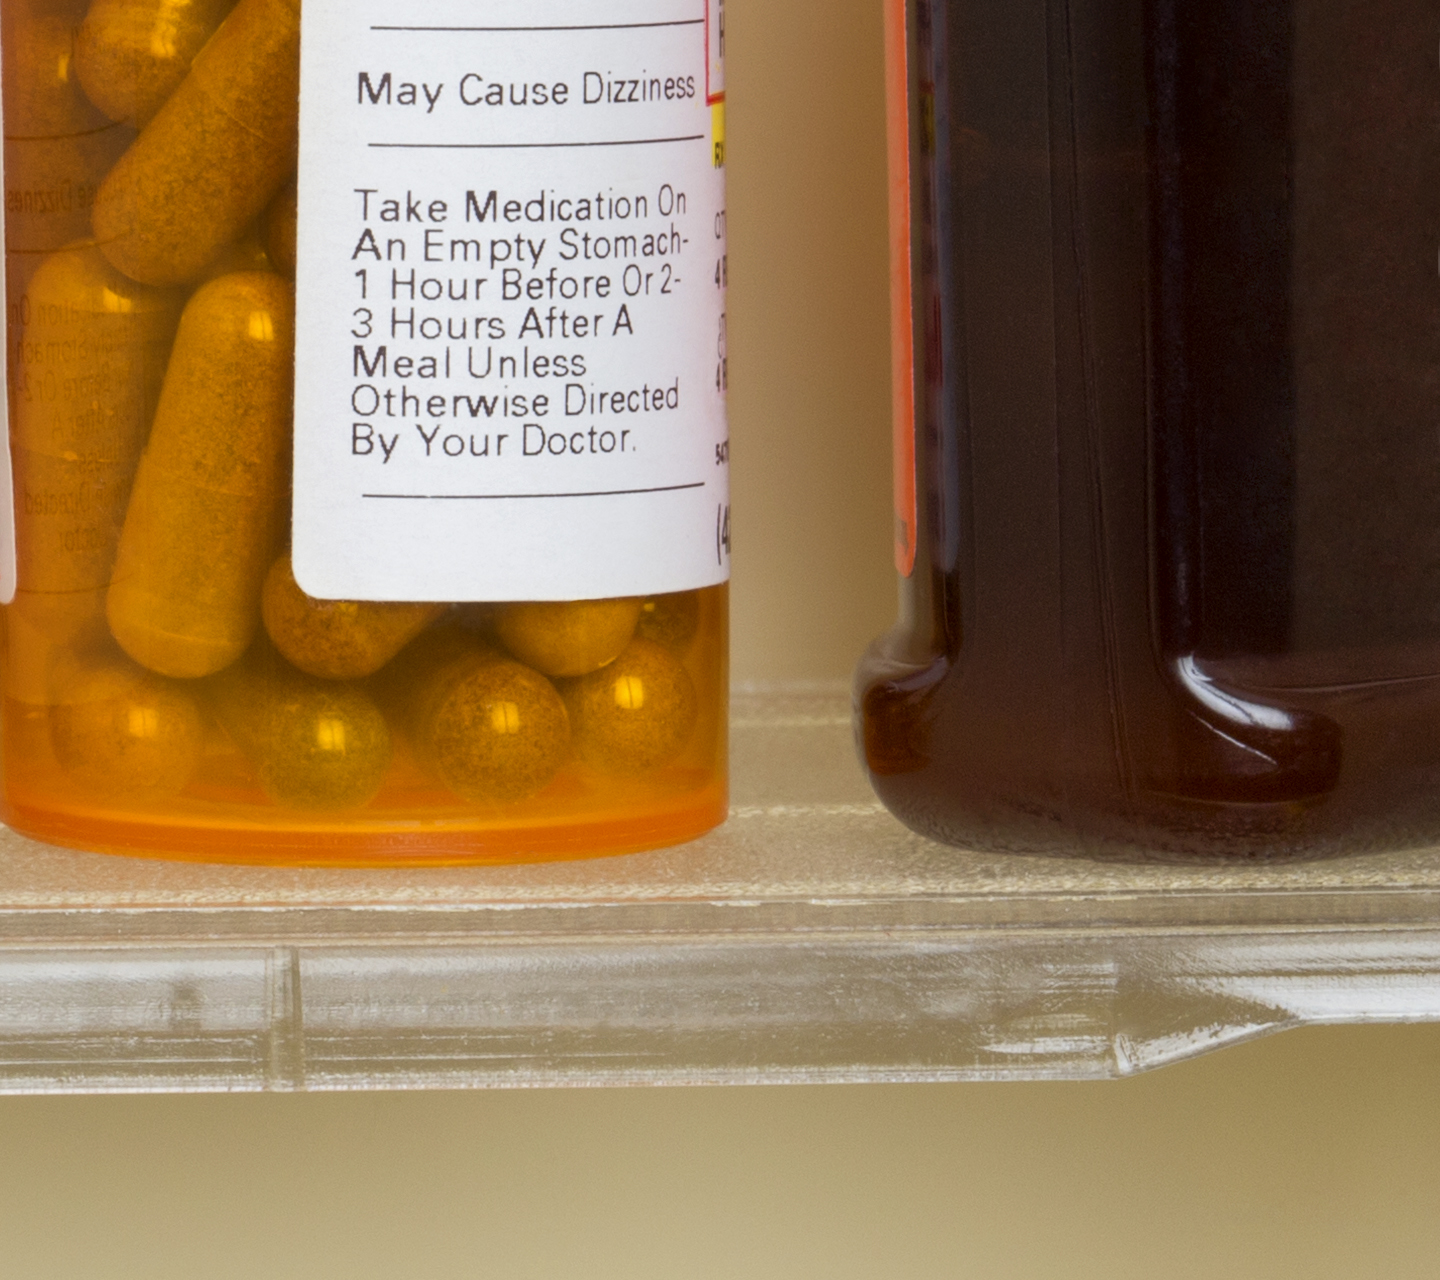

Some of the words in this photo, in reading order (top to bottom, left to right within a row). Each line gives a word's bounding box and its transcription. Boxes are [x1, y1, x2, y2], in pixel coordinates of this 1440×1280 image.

[357, 71, 444, 114] May
[459, 72, 569, 107] Cause
[582, 71, 696, 105] Dizziness
[353, 188, 448, 223] Take
[465, 189, 648, 223] Medication
[657, 183, 686, 217] On
[350, 227, 406, 262] An
[423, 228, 547, 271] Empty
[558, 222, 689, 261] Stomach-
[354, 268, 367, 300] 1
[391, 267, 488, 301] Hour
[501, 266, 611, 301] Before
[622, 263, 654, 297] Or
[350, 307, 373, 339] 3
[390, 306, 506, 341] Hours
[517, 305, 604, 340] After
[611, 303, 634, 337] A
[352, 344, 451, 379] Meal
[467, 345, 587, 379] Unless
[350, 383, 550, 418] Otherwise
[564, 376, 679, 417] Directed
[351, 422, 400, 465] By
[415, 423, 509, 457] Your
[522, 421, 641, 458] Doctor.
